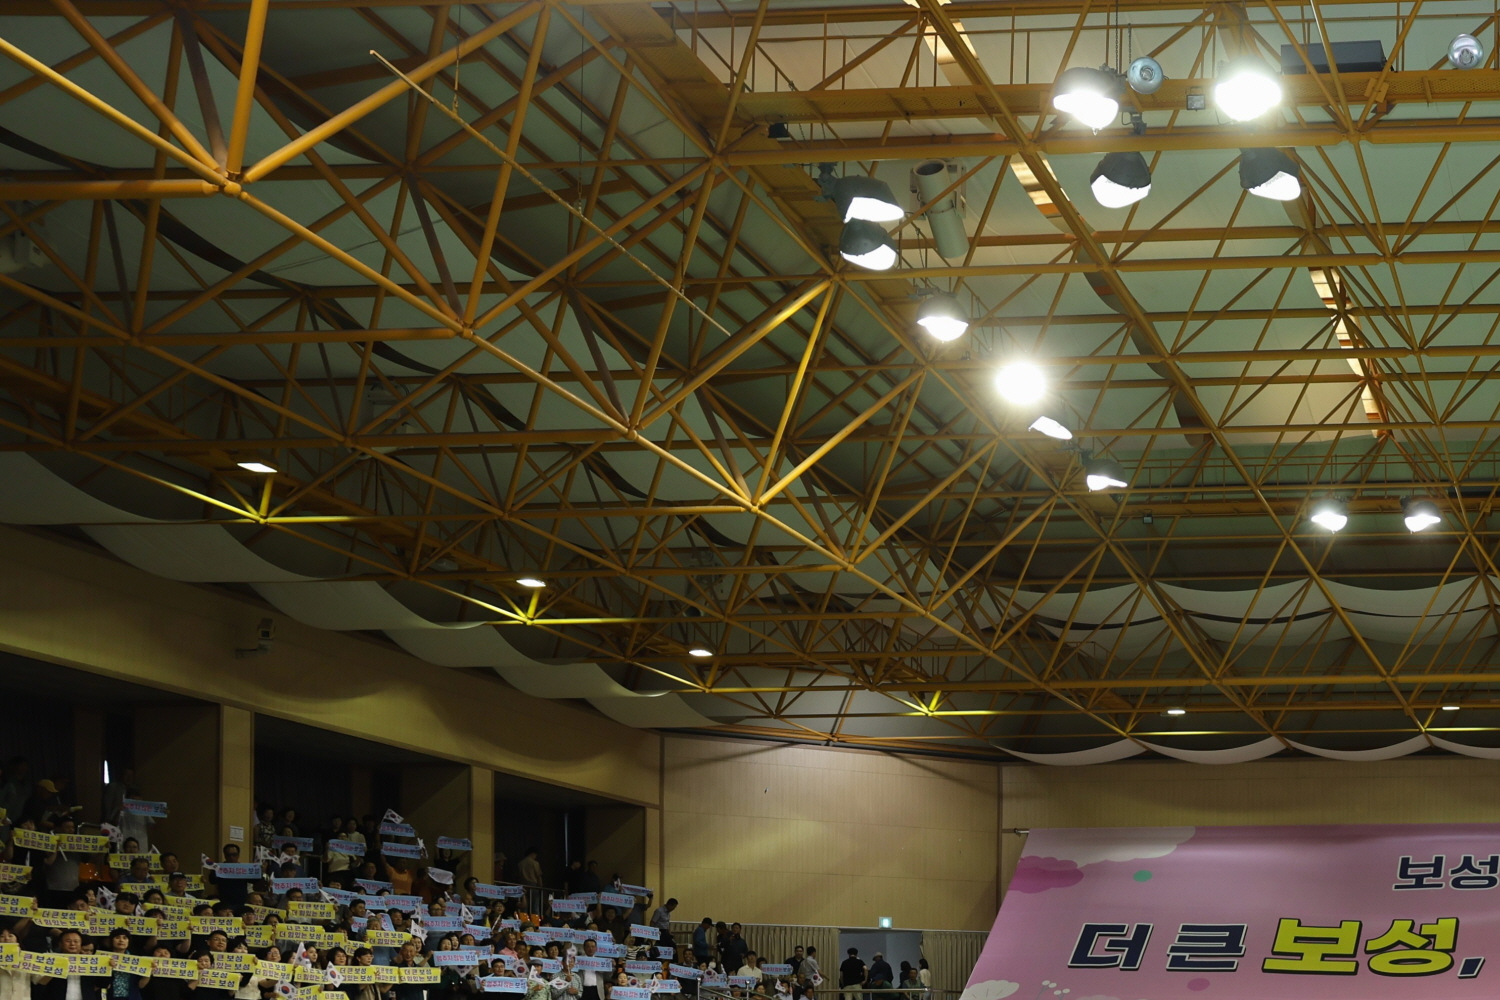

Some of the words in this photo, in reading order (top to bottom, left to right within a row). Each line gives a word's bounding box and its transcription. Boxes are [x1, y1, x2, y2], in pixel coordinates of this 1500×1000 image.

[1068, 922, 1153, 970] 더
[1167, 923, 1247, 971] 큰
[1263, 917, 1484, 978] 보성,
